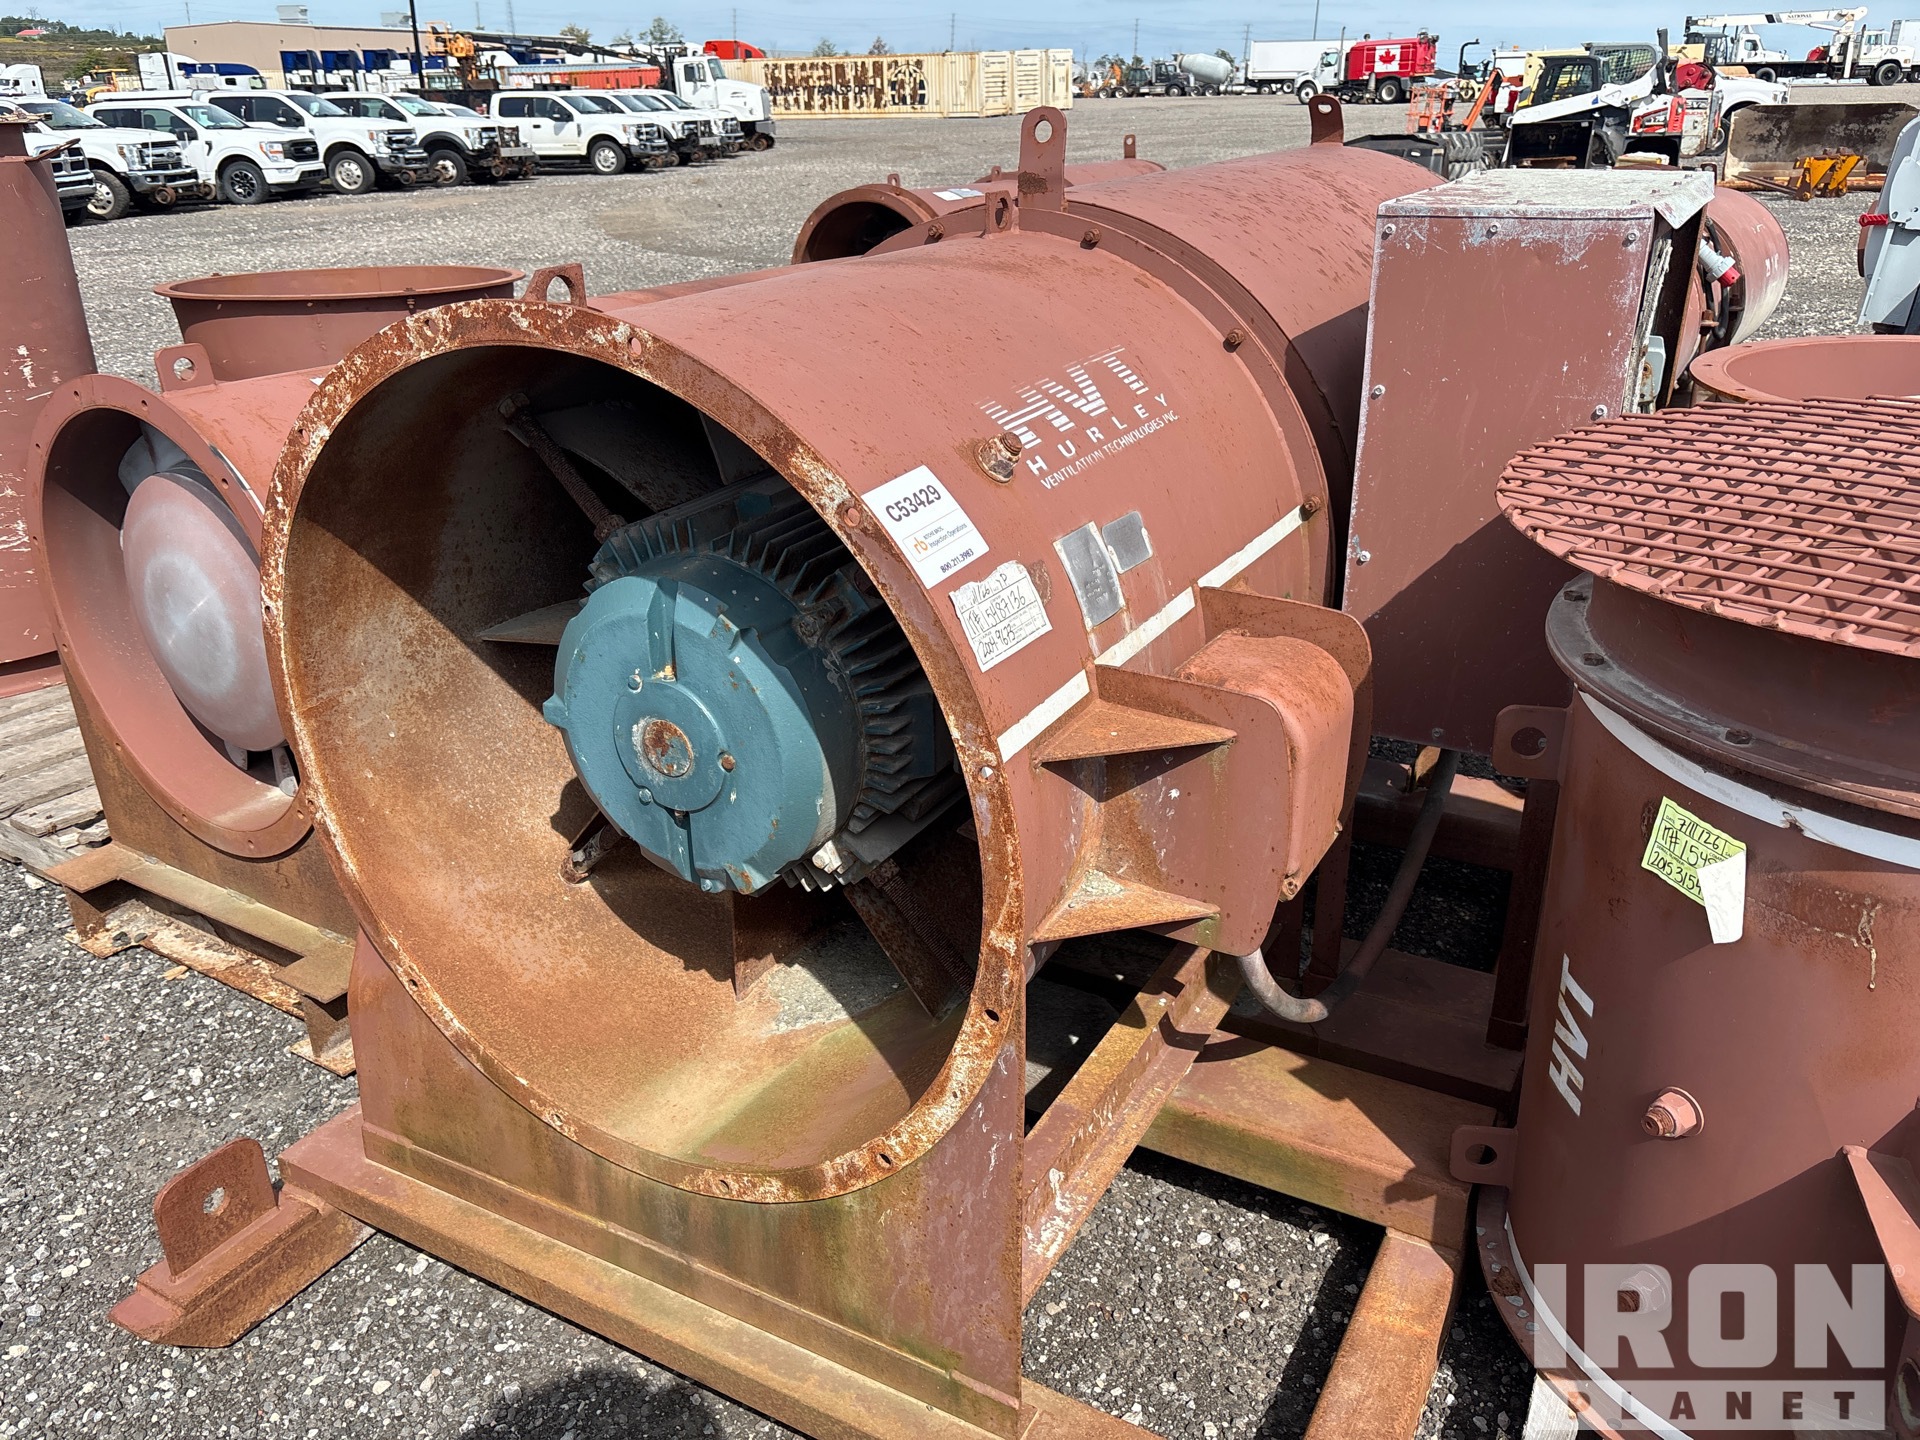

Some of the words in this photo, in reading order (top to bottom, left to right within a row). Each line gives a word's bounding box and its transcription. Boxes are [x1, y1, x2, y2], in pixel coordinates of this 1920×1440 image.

[1025, 392, 1168, 477] HURLEY
[1040, 450, 1105, 490] VENTILATION
[1102, 418, 1166, 456] TECHNOLOGIES
[885, 484, 942, 523] C53429
[928, 533, 948, 549] Inspection
[946, 523, 968, 539] Operations
[940, 548, 974, 573] 800.211.3983
[1548, 952, 1594, 1117] HVT
